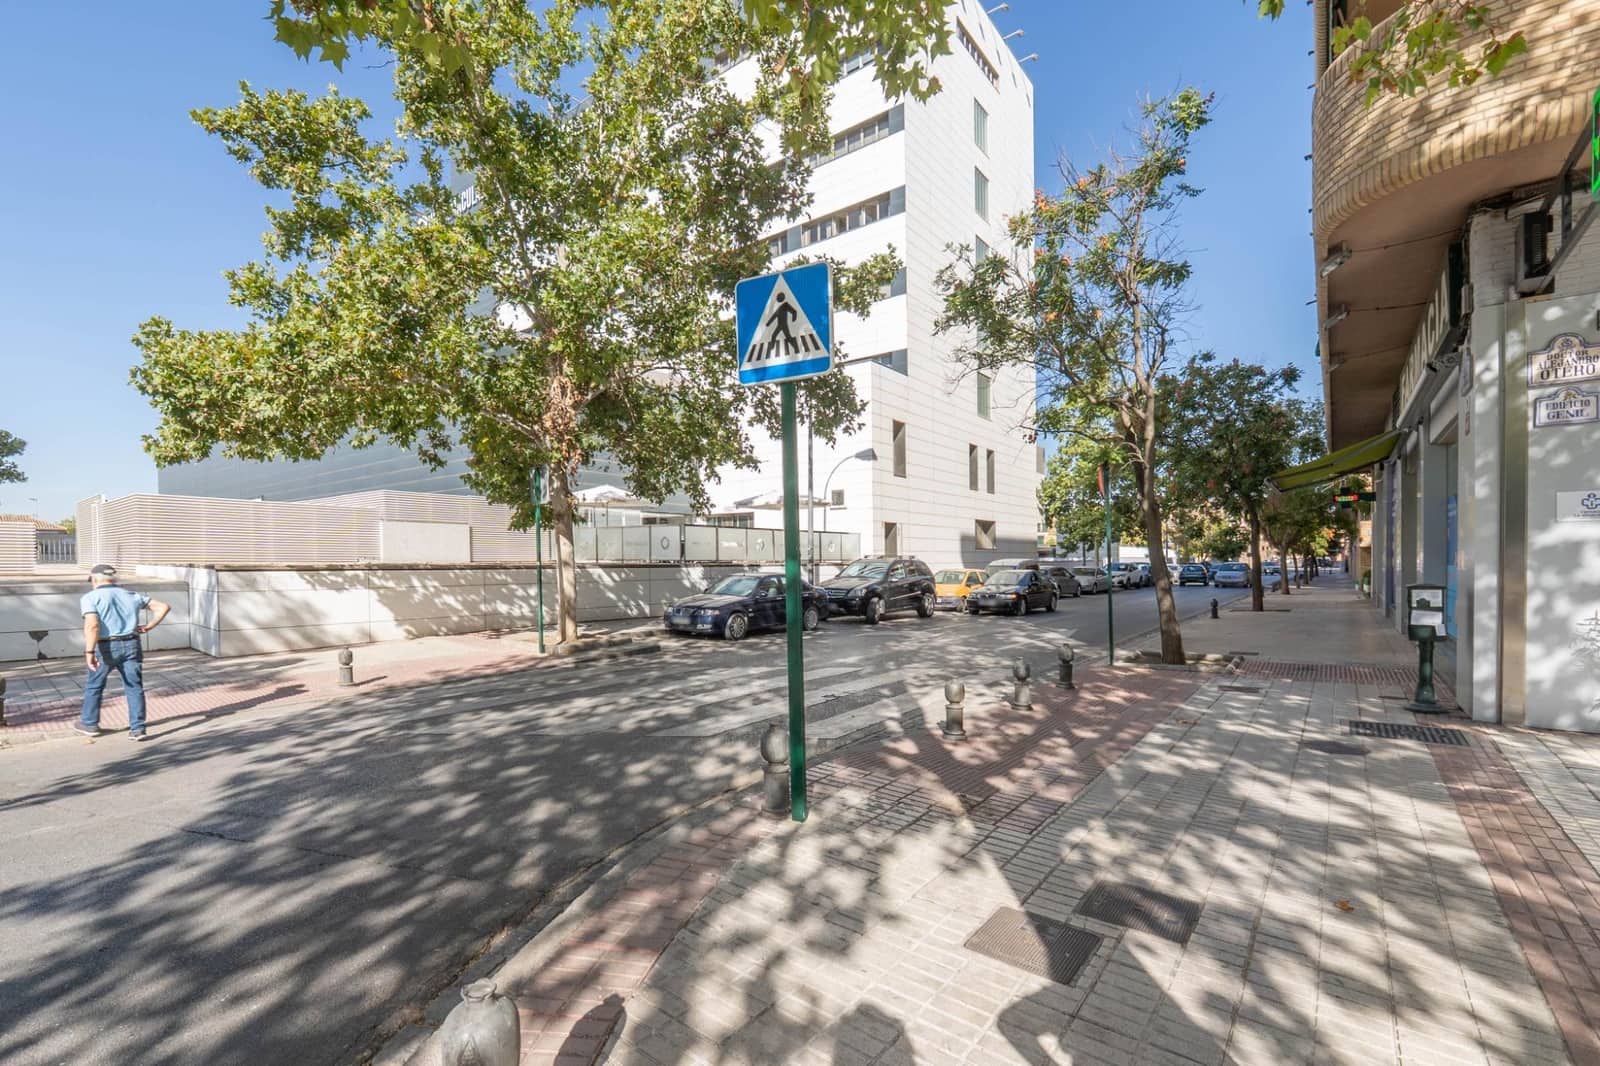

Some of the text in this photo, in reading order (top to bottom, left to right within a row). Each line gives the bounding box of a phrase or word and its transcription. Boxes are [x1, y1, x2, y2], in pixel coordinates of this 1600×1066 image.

[1401, 271, 1449, 411] FARMACIA
[1547, 350, 1589, 361] DOCTOR
[1537, 355, 1600, 370] ALEJANDRO
[1540, 364, 1596, 380] OTERO
[1546, 399, 1590, 410] EDIFICIO
[1547, 408, 1588, 420] GENIL
